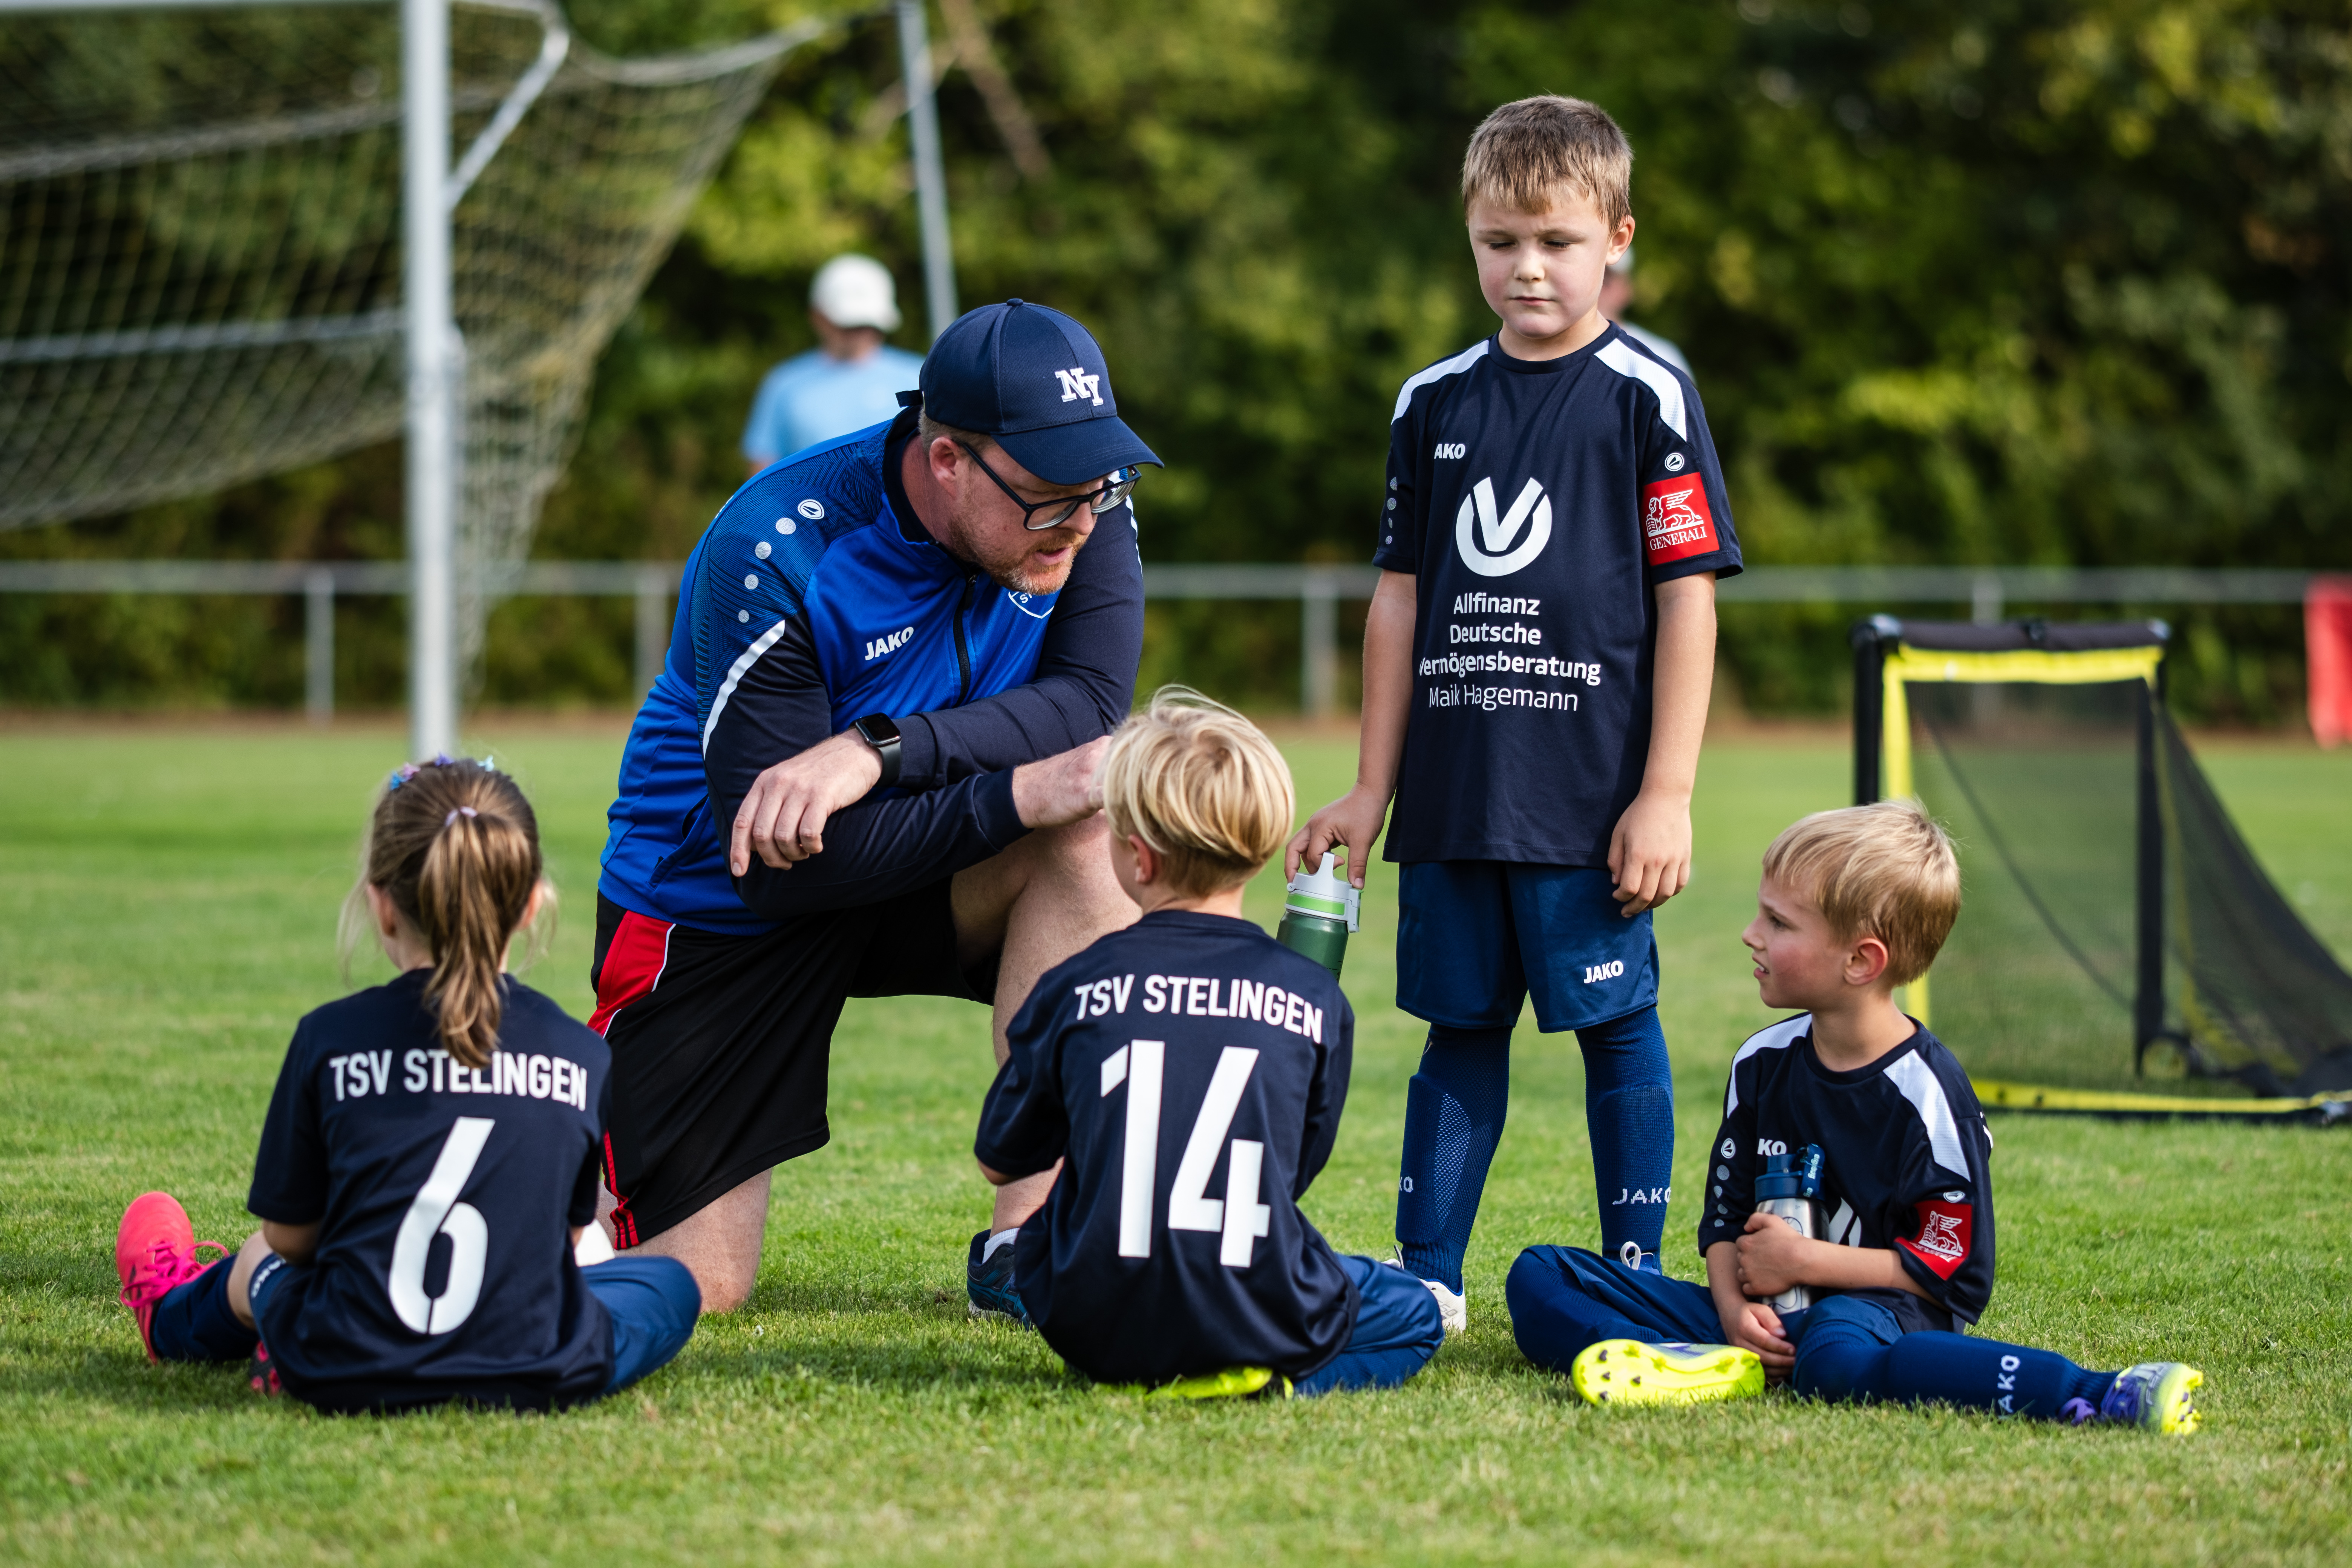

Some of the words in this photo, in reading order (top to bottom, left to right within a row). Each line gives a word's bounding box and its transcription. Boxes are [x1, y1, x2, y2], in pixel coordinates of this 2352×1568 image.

[1055, 367, 1104, 406] NY
[1434, 444, 1465, 459] AKO
[1650, 526, 1707, 550] GENERALI
[1454, 592, 1540, 616] Allfinanz
[865, 626, 914, 661] JAKO
[1450, 622, 1541, 645] Deutsche
[1419, 650, 1601, 686] Vermögensberatung
[1429, 684, 1460, 708] Maik
[1464, 684, 1578, 711] Hagemann
[1583, 960, 1623, 984] JAKO
[1075, 974, 1135, 1020] TSV
[1143, 974, 1323, 1044] STELINGEN
[329, 1049, 393, 1101] TSV
[403, 1049, 587, 1112] STELINGEN
[1101, 1039, 1271, 1268] 14
[1757, 1138, 1787, 1156] KO
[388, 1116, 496, 1335] 6
[1997, 1355, 2021, 1419] AKO
